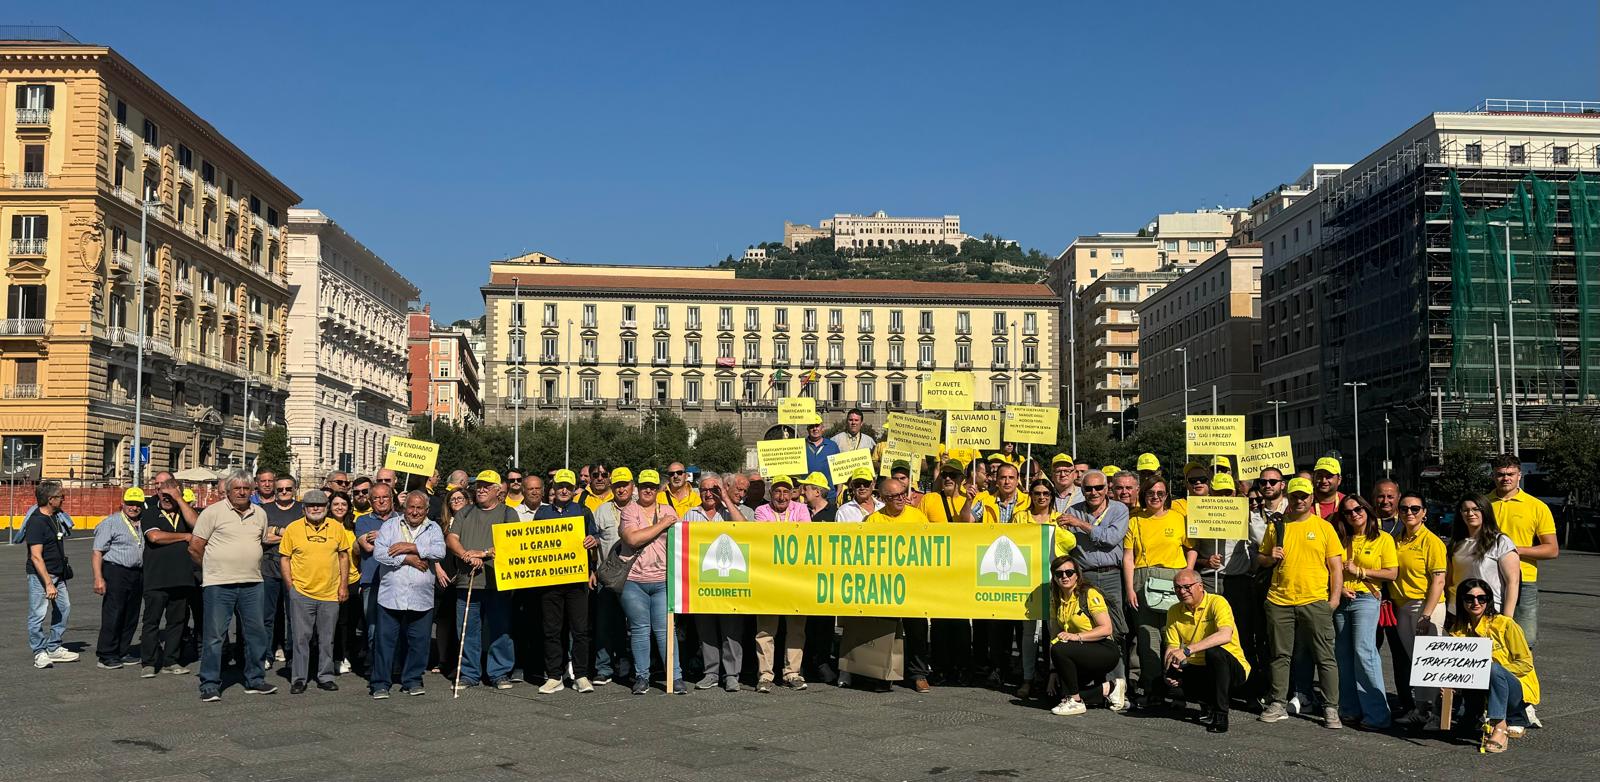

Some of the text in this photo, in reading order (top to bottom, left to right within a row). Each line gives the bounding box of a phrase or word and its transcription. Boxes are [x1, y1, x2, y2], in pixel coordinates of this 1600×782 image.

[904, 417, 932, 426] SVENDIAMO
[902, 432, 930, 440] SVENDIAMO
[394, 441, 433, 452] DIFENDIAMO
[1250, 441, 1274, 449] SENZA
[404, 452, 426, 460] GRANO
[1241, 451, 1288, 462] AGRICOLTORI
[396, 460, 424, 470] ITALIANO
[506, 523, 574, 538] NON SVENDIAMO
[520, 539, 562, 551] IL GRANO
[773, 534, 950, 566] NO AI TRAFFICANTI
[509, 552, 576, 566] NON SVENDIAMO
[501, 572, 512, 580] LA
[514, 568, 547, 578] NOSTRA
[698, 588, 751, 598] COLDIRETTI
[817, 573, 906, 605] DI GRANO
[1426, 641, 1478, 652] FERMIAMO
[1414, 656, 1489, 668] I TRAFFICANTI
[1423, 672, 1474, 684] DI GRANO!
